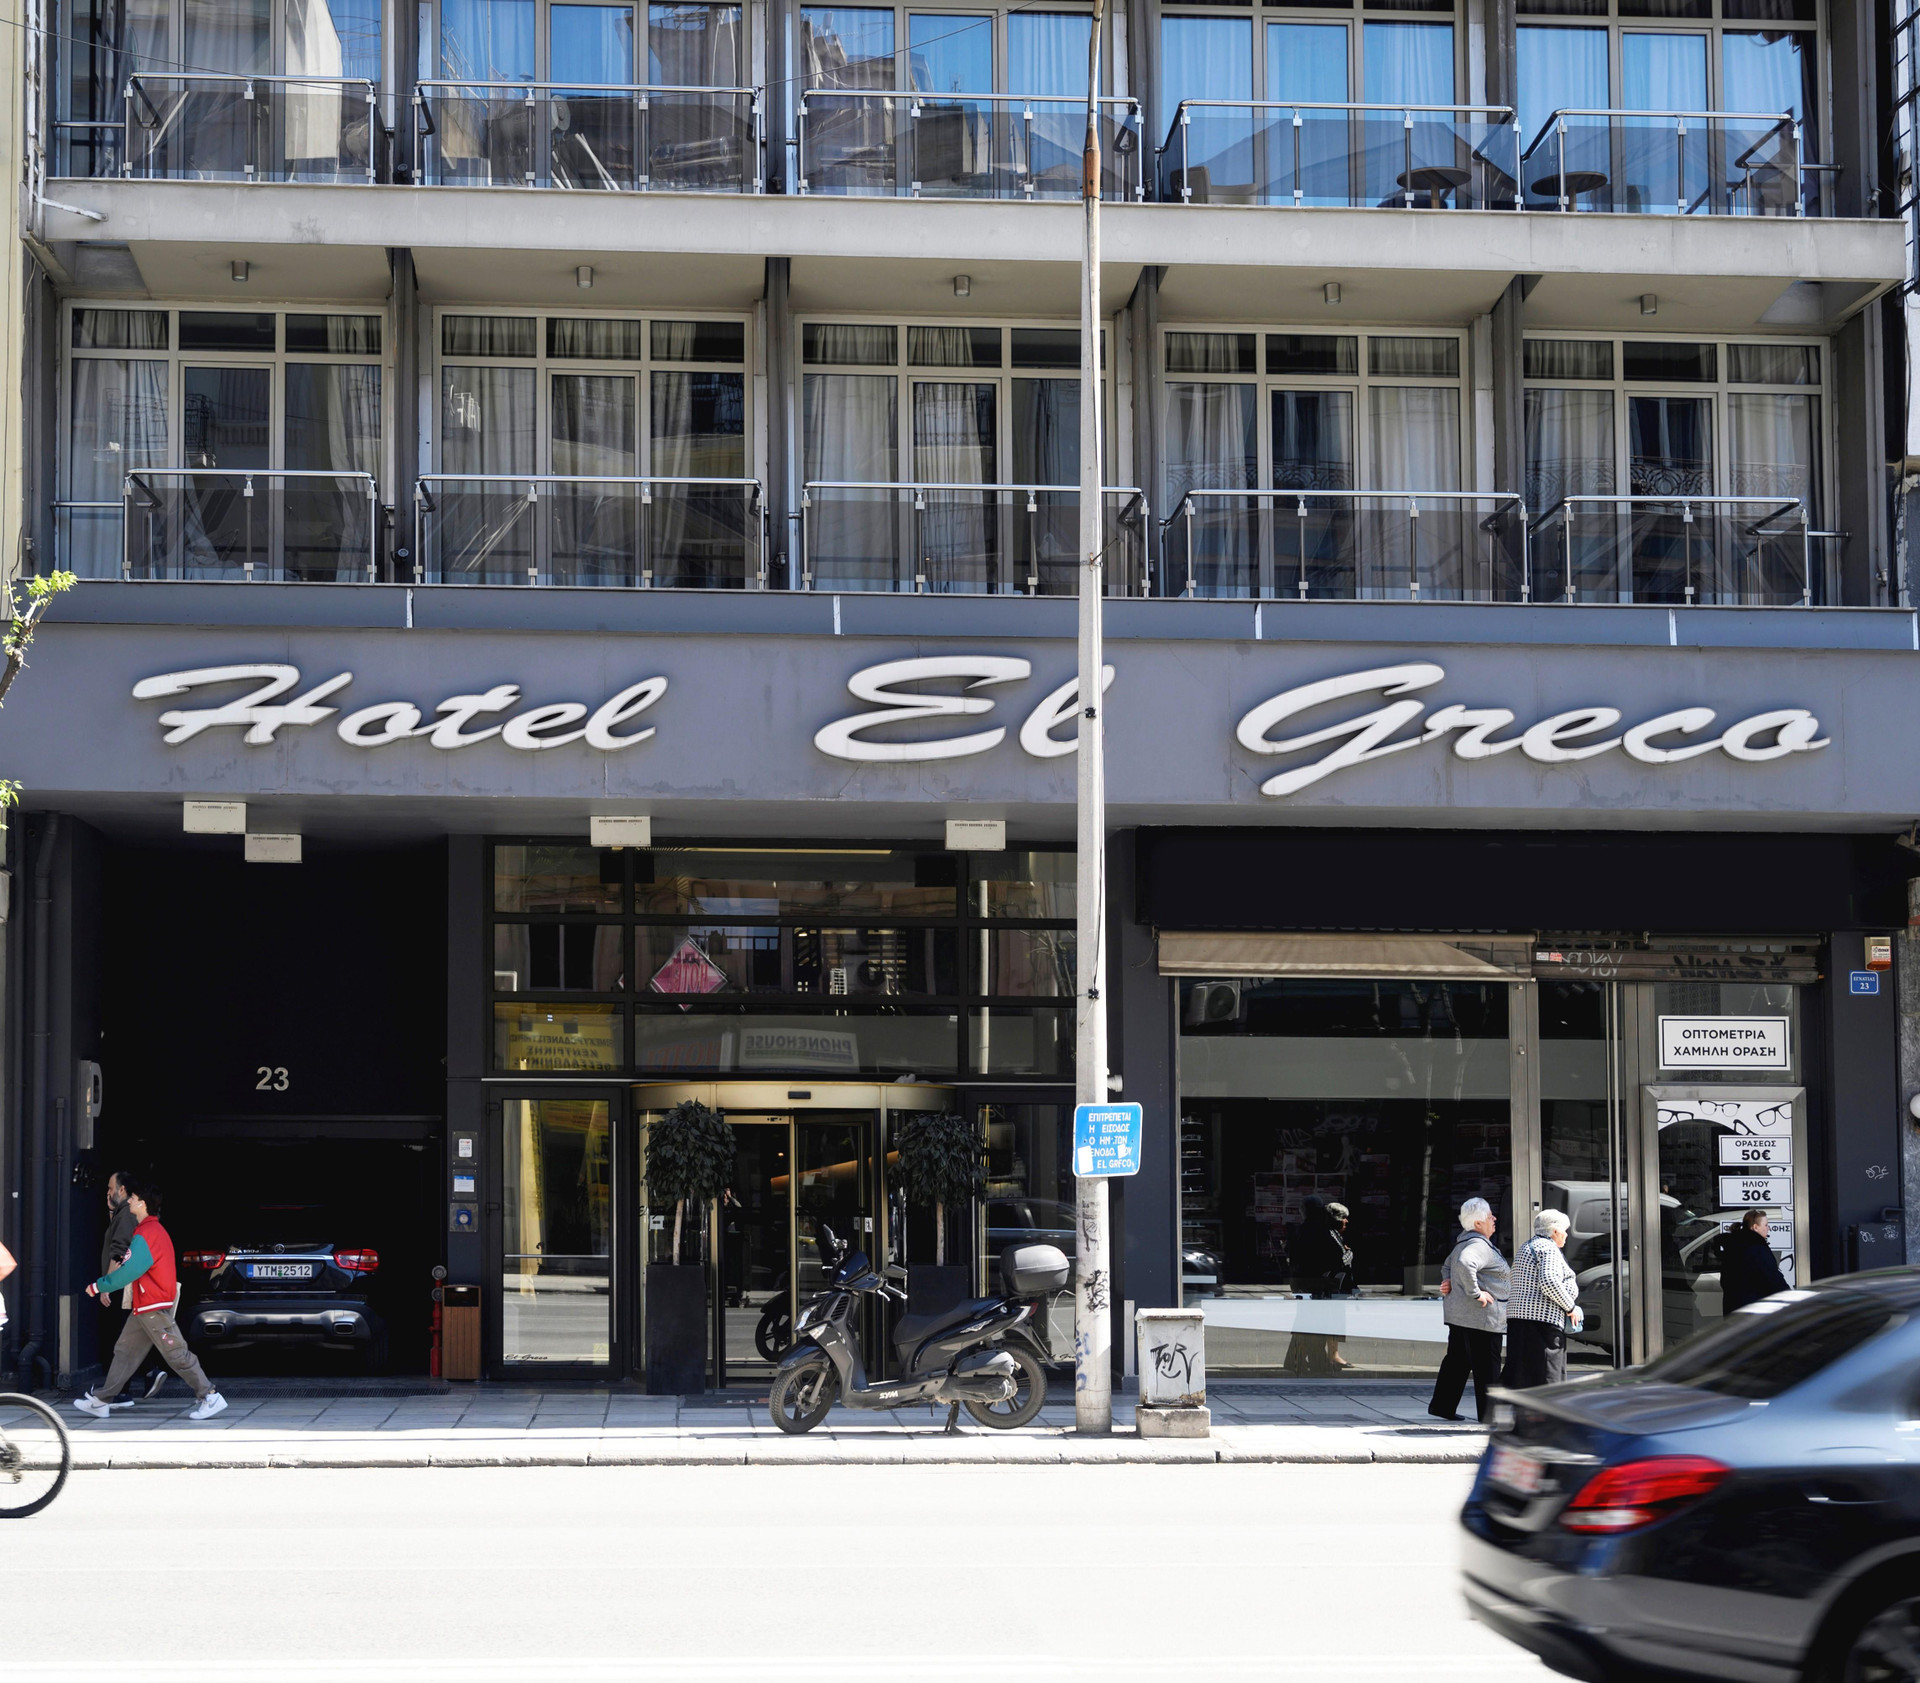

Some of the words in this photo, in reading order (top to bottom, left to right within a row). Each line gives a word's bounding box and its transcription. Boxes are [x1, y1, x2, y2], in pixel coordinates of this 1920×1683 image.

[132, 662, 669, 751] Hotel
[813, 654, 1116, 763] El
[1236, 660, 1831, 798] Greco
[1860, 982, 1870, 990] 23
[1682, 1029, 1766, 1040] ΟΠΤΟΜΕΤΡΙΑ
[1673, 1046, 1729, 1056] ΧΑΜΗΛΗ
[1732, 1046, 1777, 1057] ΟΡΑΣΗ
[255, 1066, 290, 1091] 23
[1088, 1112, 1131, 1122] ΕΠΙΤΡΕΠΕΤΑΙ
[1088, 1125, 1095, 1133] Η
[1101, 1123, 1130, 1133] ΕΙΣΟΔΟΣ
[1741, 1149, 1771, 1161] 50€
[1097, 1160, 1107, 1168] EL
[1741, 1189, 1771, 1201] 30€
[257, 1265, 278, 1276] YTM
[283, 1265, 311, 1276] 2512
[879, 1390, 899, 1400] SYM
